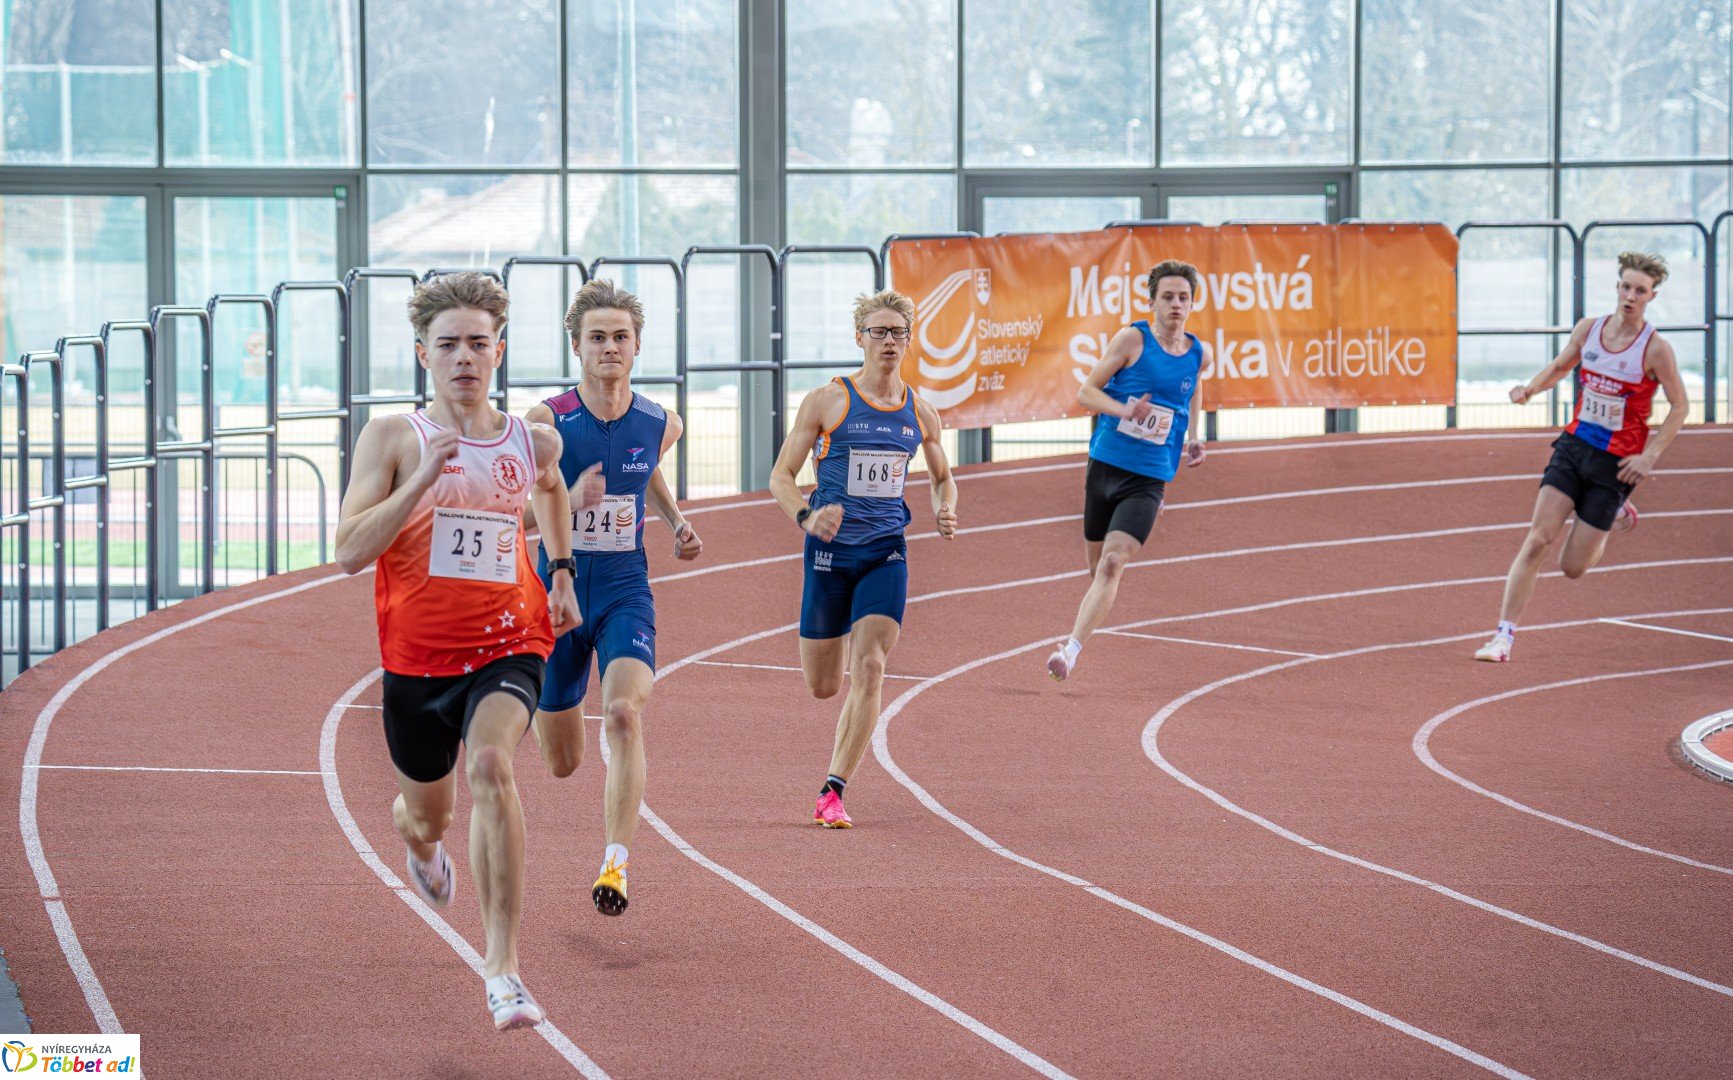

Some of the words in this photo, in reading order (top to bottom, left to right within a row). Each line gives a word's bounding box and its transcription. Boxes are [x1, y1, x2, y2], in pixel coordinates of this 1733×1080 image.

[1066, 254, 1313, 325] Majsovstvá
[977, 313, 1044, 341] Slovenský
[980, 340, 1031, 368] atletický
[1273, 339, 1294, 377] v
[1303, 325, 1426, 379] atletike
[977, 370, 1006, 392] zväz
[1586, 398, 1606, 417] 231
[622, 462, 649, 470] NASA
[856, 462, 889, 482] 168
[571, 510, 611, 533] 124
[451, 528, 483, 558] 25
